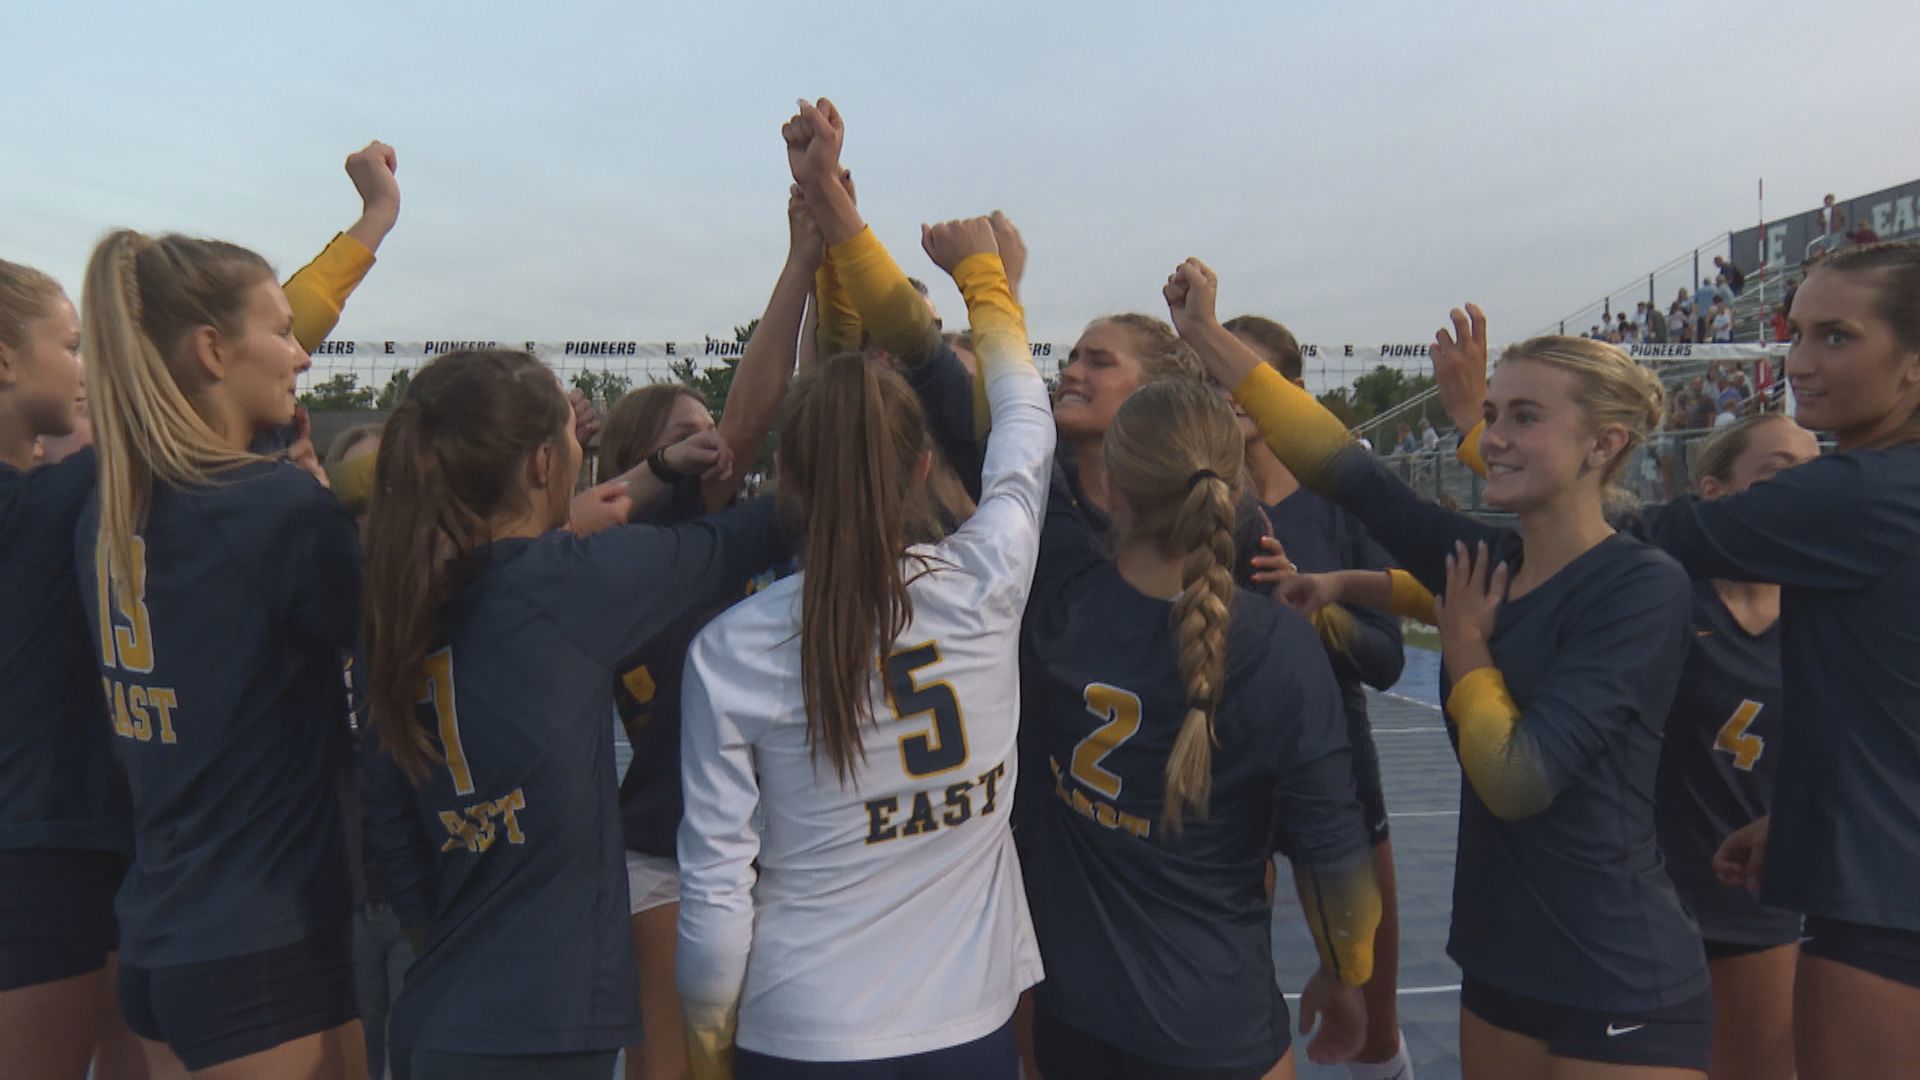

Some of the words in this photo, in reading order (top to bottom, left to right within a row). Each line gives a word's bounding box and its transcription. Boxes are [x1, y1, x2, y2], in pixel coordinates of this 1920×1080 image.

[1767, 224, 1788, 267] E
[1872, 196, 1920, 237] EA
[313, 341, 355, 354] EERS
[385, 341, 395, 354] E
[565, 341, 637, 355] PIONEERS
[666, 343, 676, 355] E
[1344, 344, 1354, 357] E
[1381, 344, 1433, 357] PIONEE
[1631, 345, 1692, 357] PIONEERS
[877, 639, 970, 780] 5
[1070, 682, 1142, 800] 2
[1712, 699, 1765, 772] 4
[865, 761, 1004, 845] EAST
